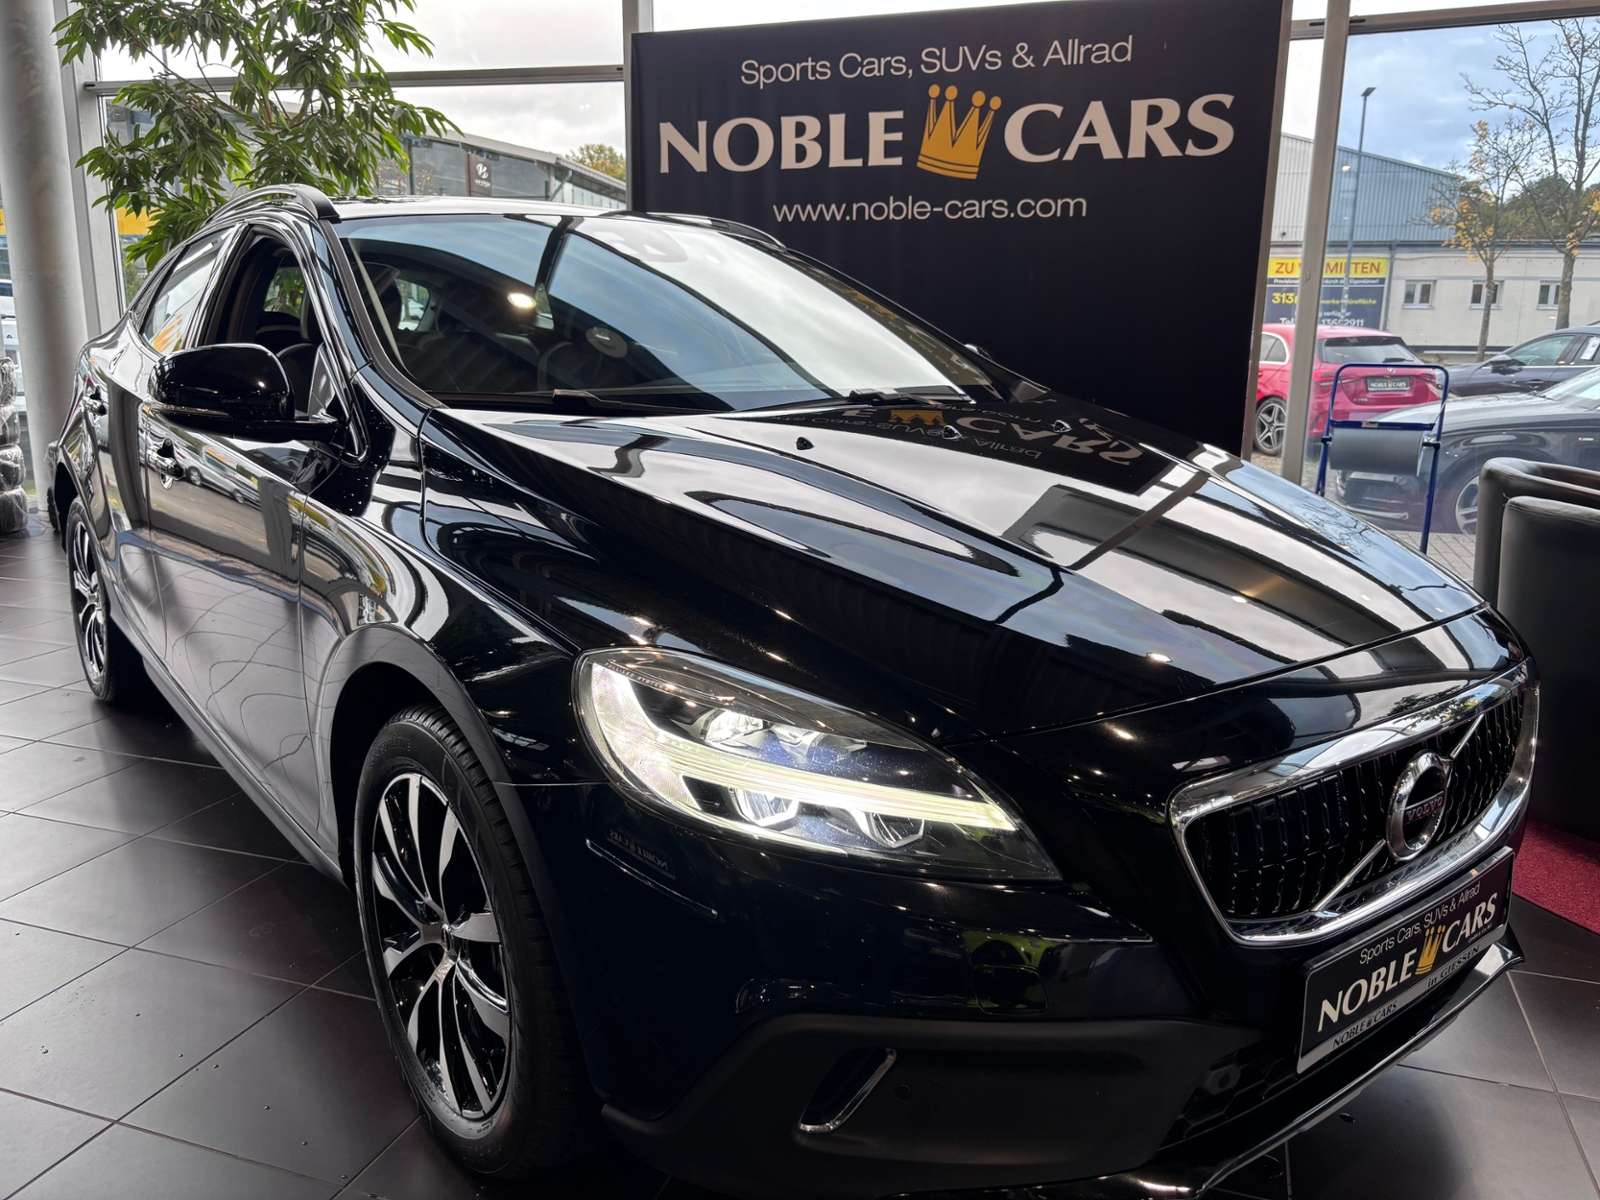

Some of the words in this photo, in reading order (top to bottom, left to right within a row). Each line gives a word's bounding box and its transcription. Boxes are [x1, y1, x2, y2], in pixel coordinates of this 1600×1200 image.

[741, 57, 831, 89] Sports
[839, 52, 913, 79] Cars,
[920, 45, 1003, 75] SUVs
[1011, 42, 1036, 68] &
[1044, 36, 1133, 67] Allrad
[658, 110, 904, 174] NOBLE
[1003, 94, 1235, 163] CARS
[773, 194, 1087, 223] www.noble-cars.com
[1275, 261, 1295, 274] ZU
[1405, 796, 1443, 822] VOLVO
[1360, 937, 1395, 965] Sports
[1449, 897, 1457, 912] &
[1458, 883, 1480, 905] Allrad
[1317, 948, 1417, 1033] NOBLE
[1442, 892, 1498, 953] CARS
[1332, 1020, 1366, 1048] NOBLE
